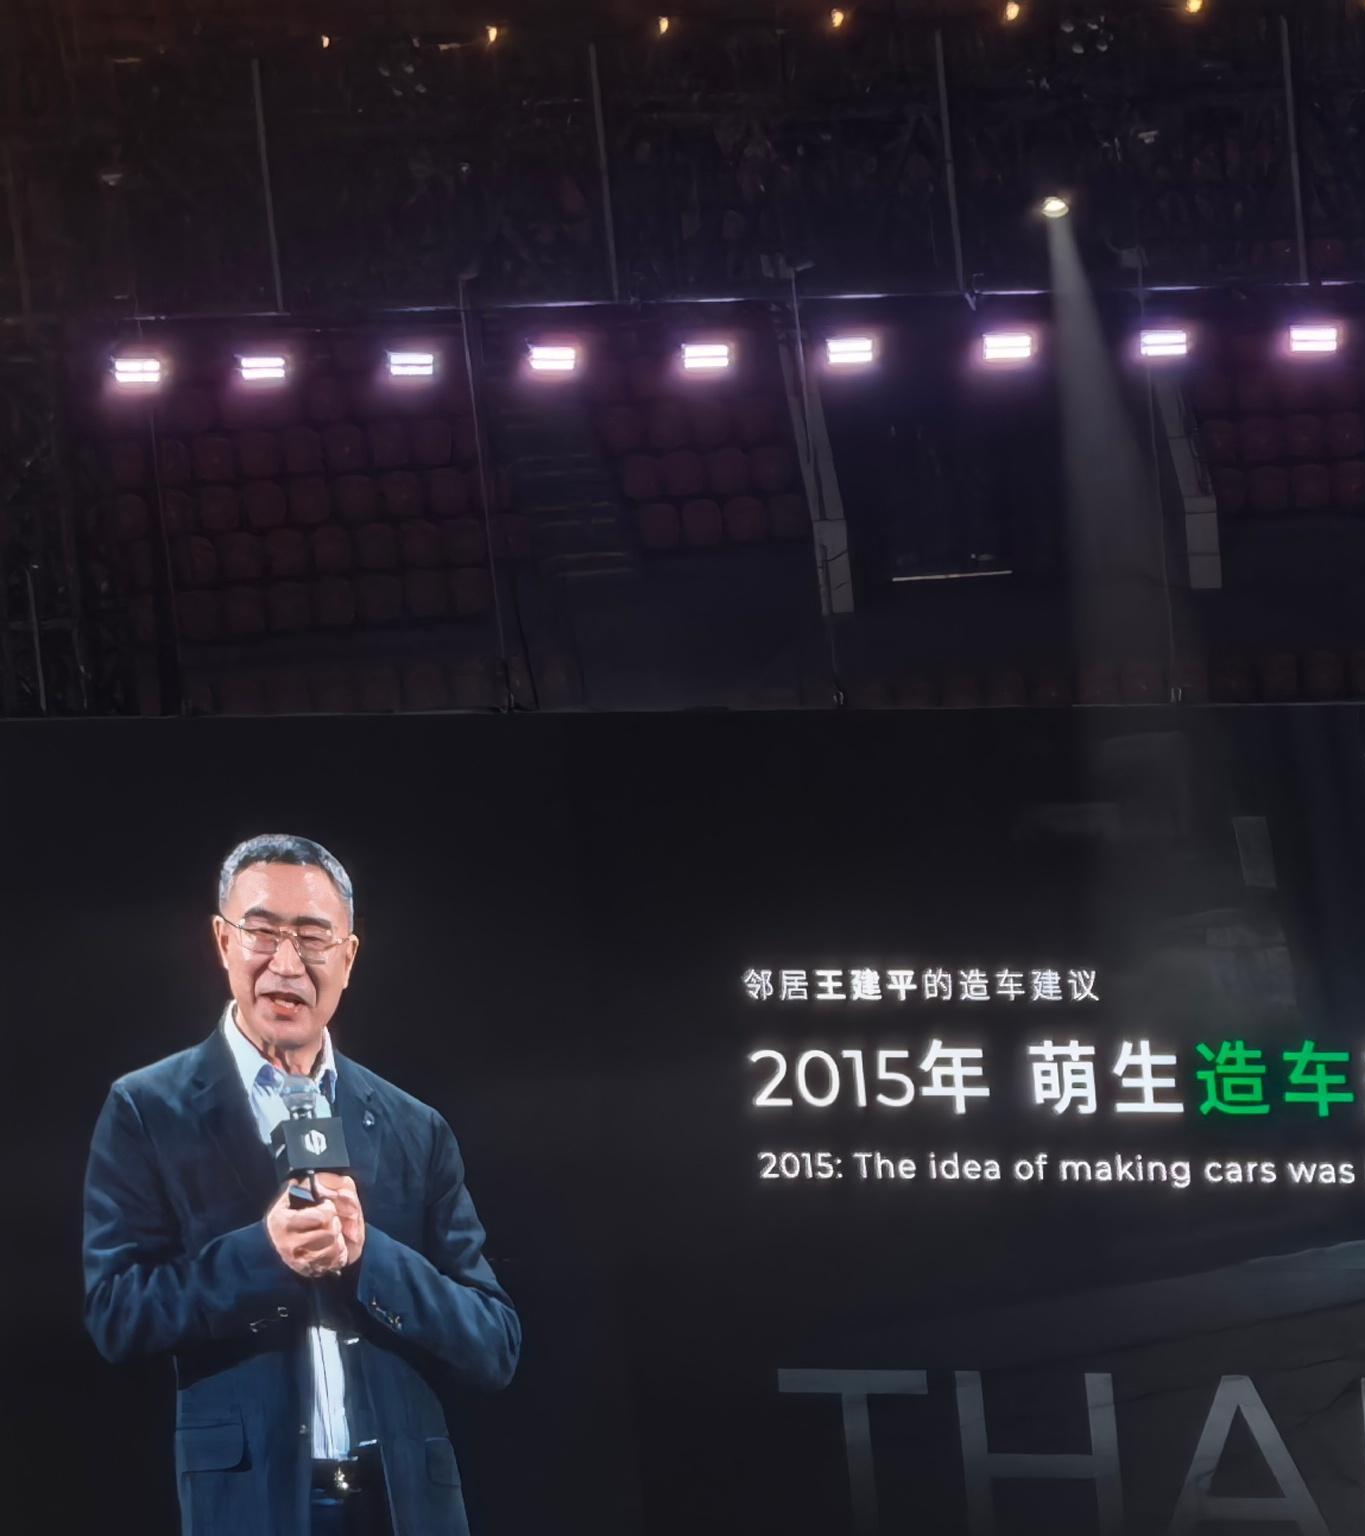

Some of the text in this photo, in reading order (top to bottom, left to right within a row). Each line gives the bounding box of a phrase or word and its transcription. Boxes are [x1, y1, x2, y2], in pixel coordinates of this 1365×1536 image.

[743, 966, 1101, 1002] 邻居王建平的造车建议
[750, 1038, 990, 1115] 2015年
[758, 1152, 843, 1179] 2015:
[853, 1152, 917, 1179] The
[930, 1152, 1001, 1180] idea
[1013, 1152, 1048, 1181] of
[1059, 1153, 1191, 1189] making
[1204, 1162, 1277, 1183] cars
[1287, 1162, 1356, 1184] was
